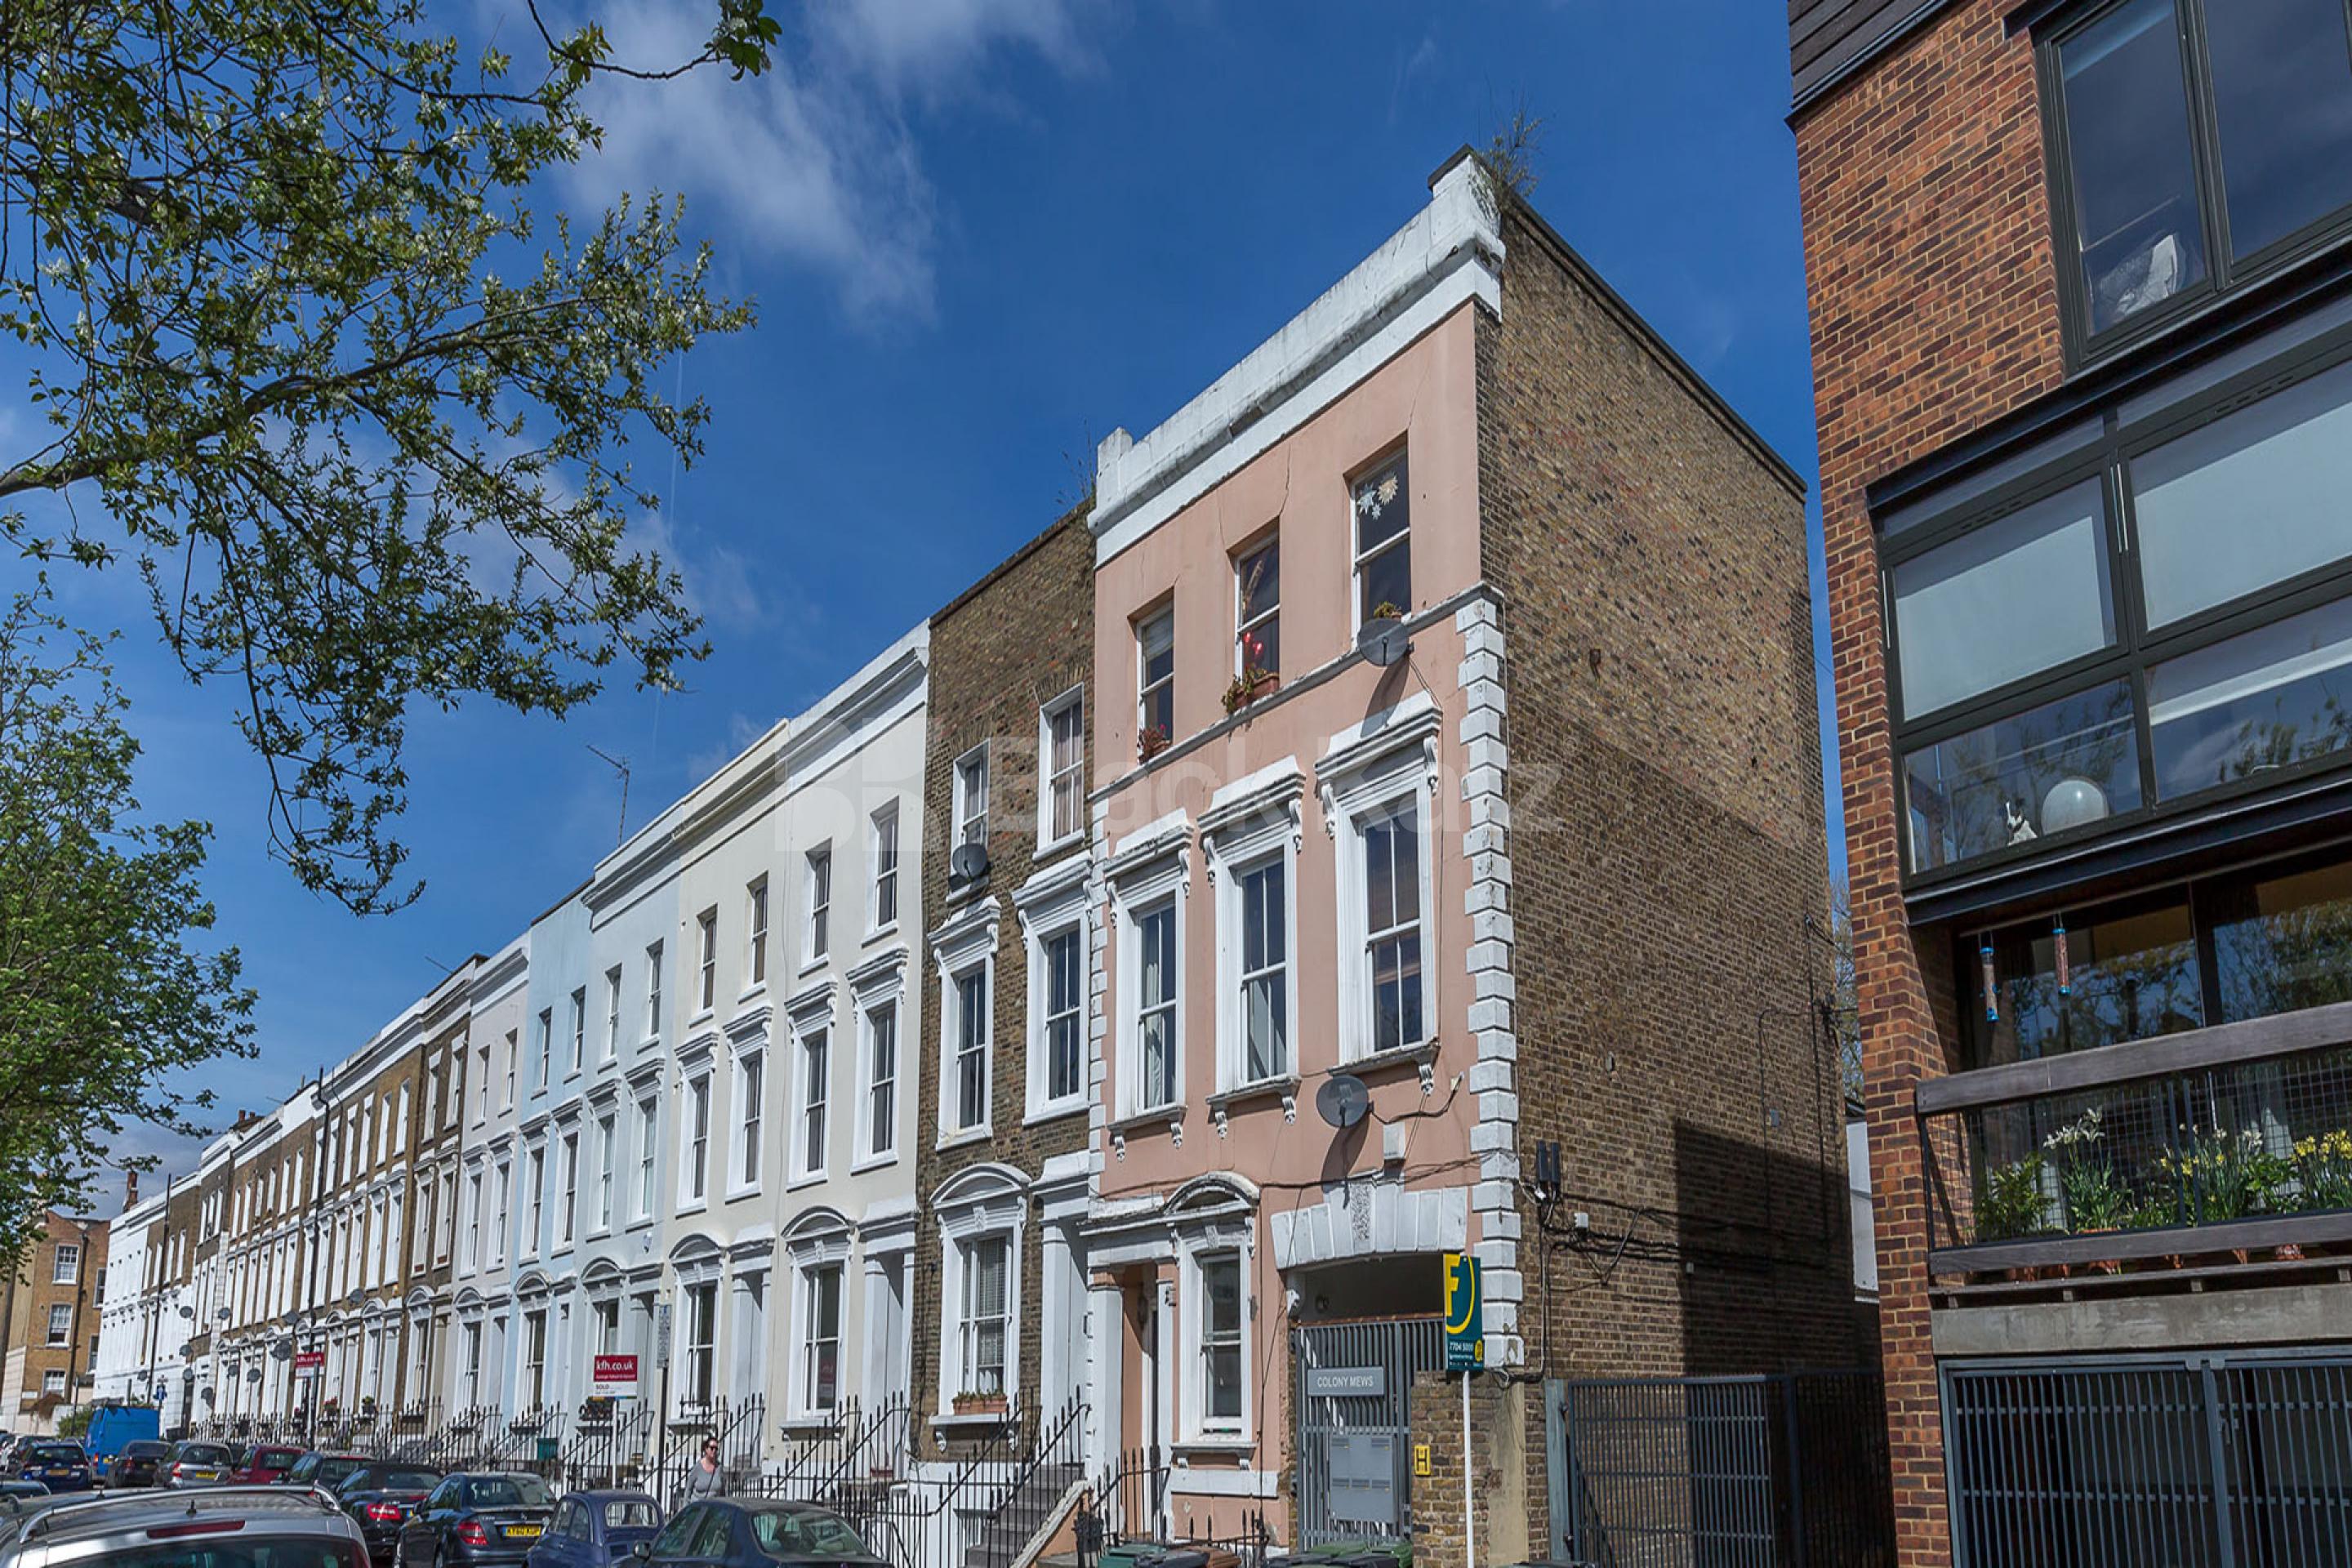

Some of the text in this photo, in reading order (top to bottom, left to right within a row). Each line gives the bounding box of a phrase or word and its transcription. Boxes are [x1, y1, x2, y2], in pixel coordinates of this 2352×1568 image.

[596, 1359, 634, 1370] kfh.co.uk
[1317, 1375, 1374, 1388] COLONY MEWS
